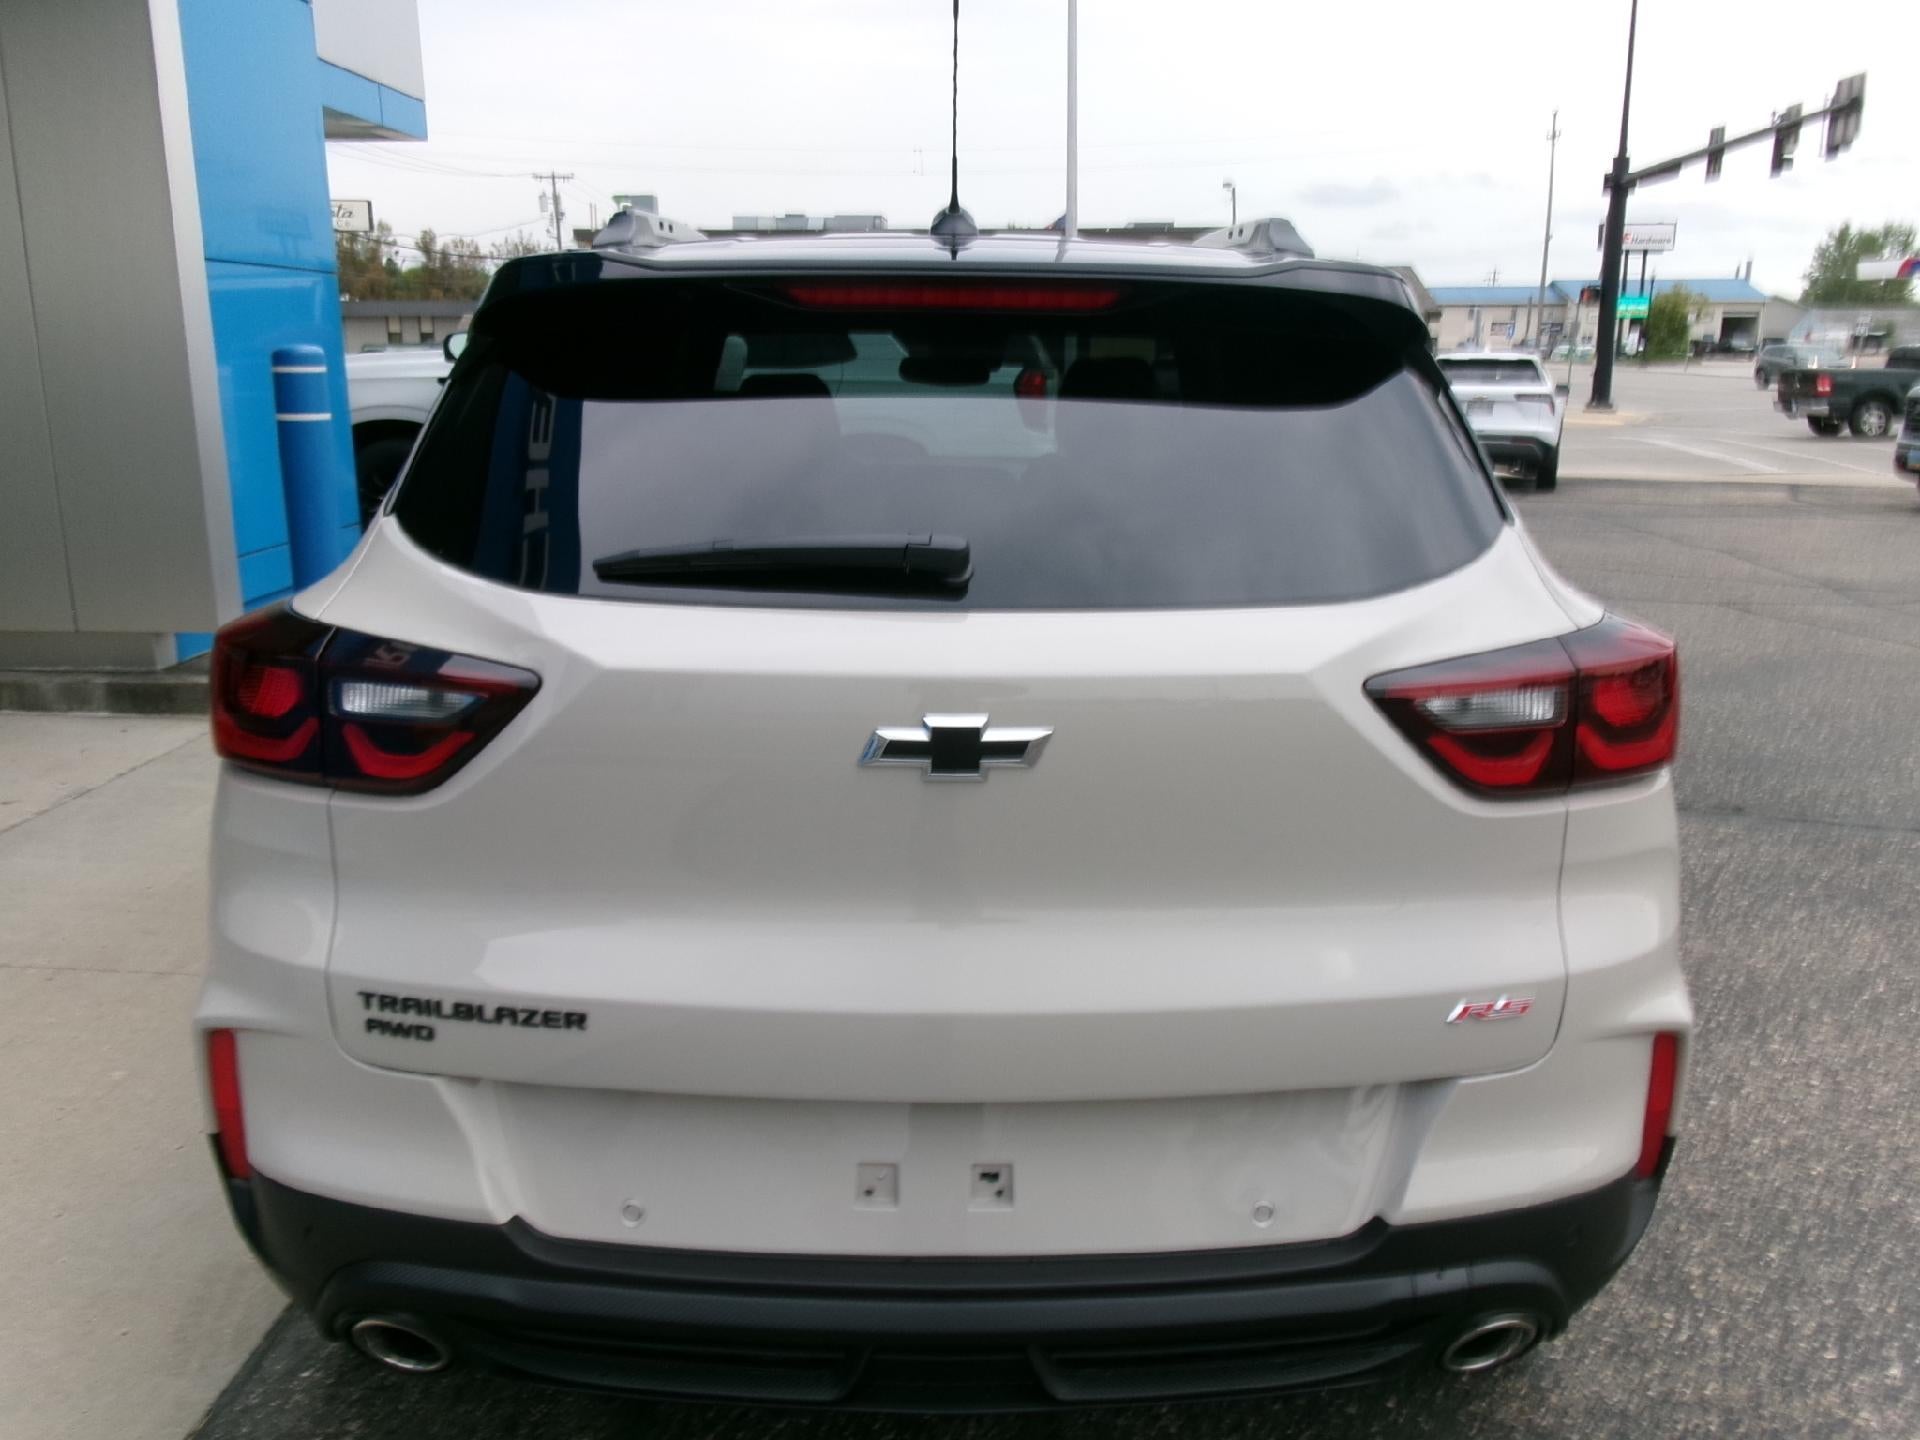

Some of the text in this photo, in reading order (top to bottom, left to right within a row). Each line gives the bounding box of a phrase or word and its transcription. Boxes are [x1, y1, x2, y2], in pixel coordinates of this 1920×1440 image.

[357, 990, 589, 1031] TRAILBLAZER
[1446, 995, 1535, 1023] RS
[365, 1017, 436, 1042] AWD
